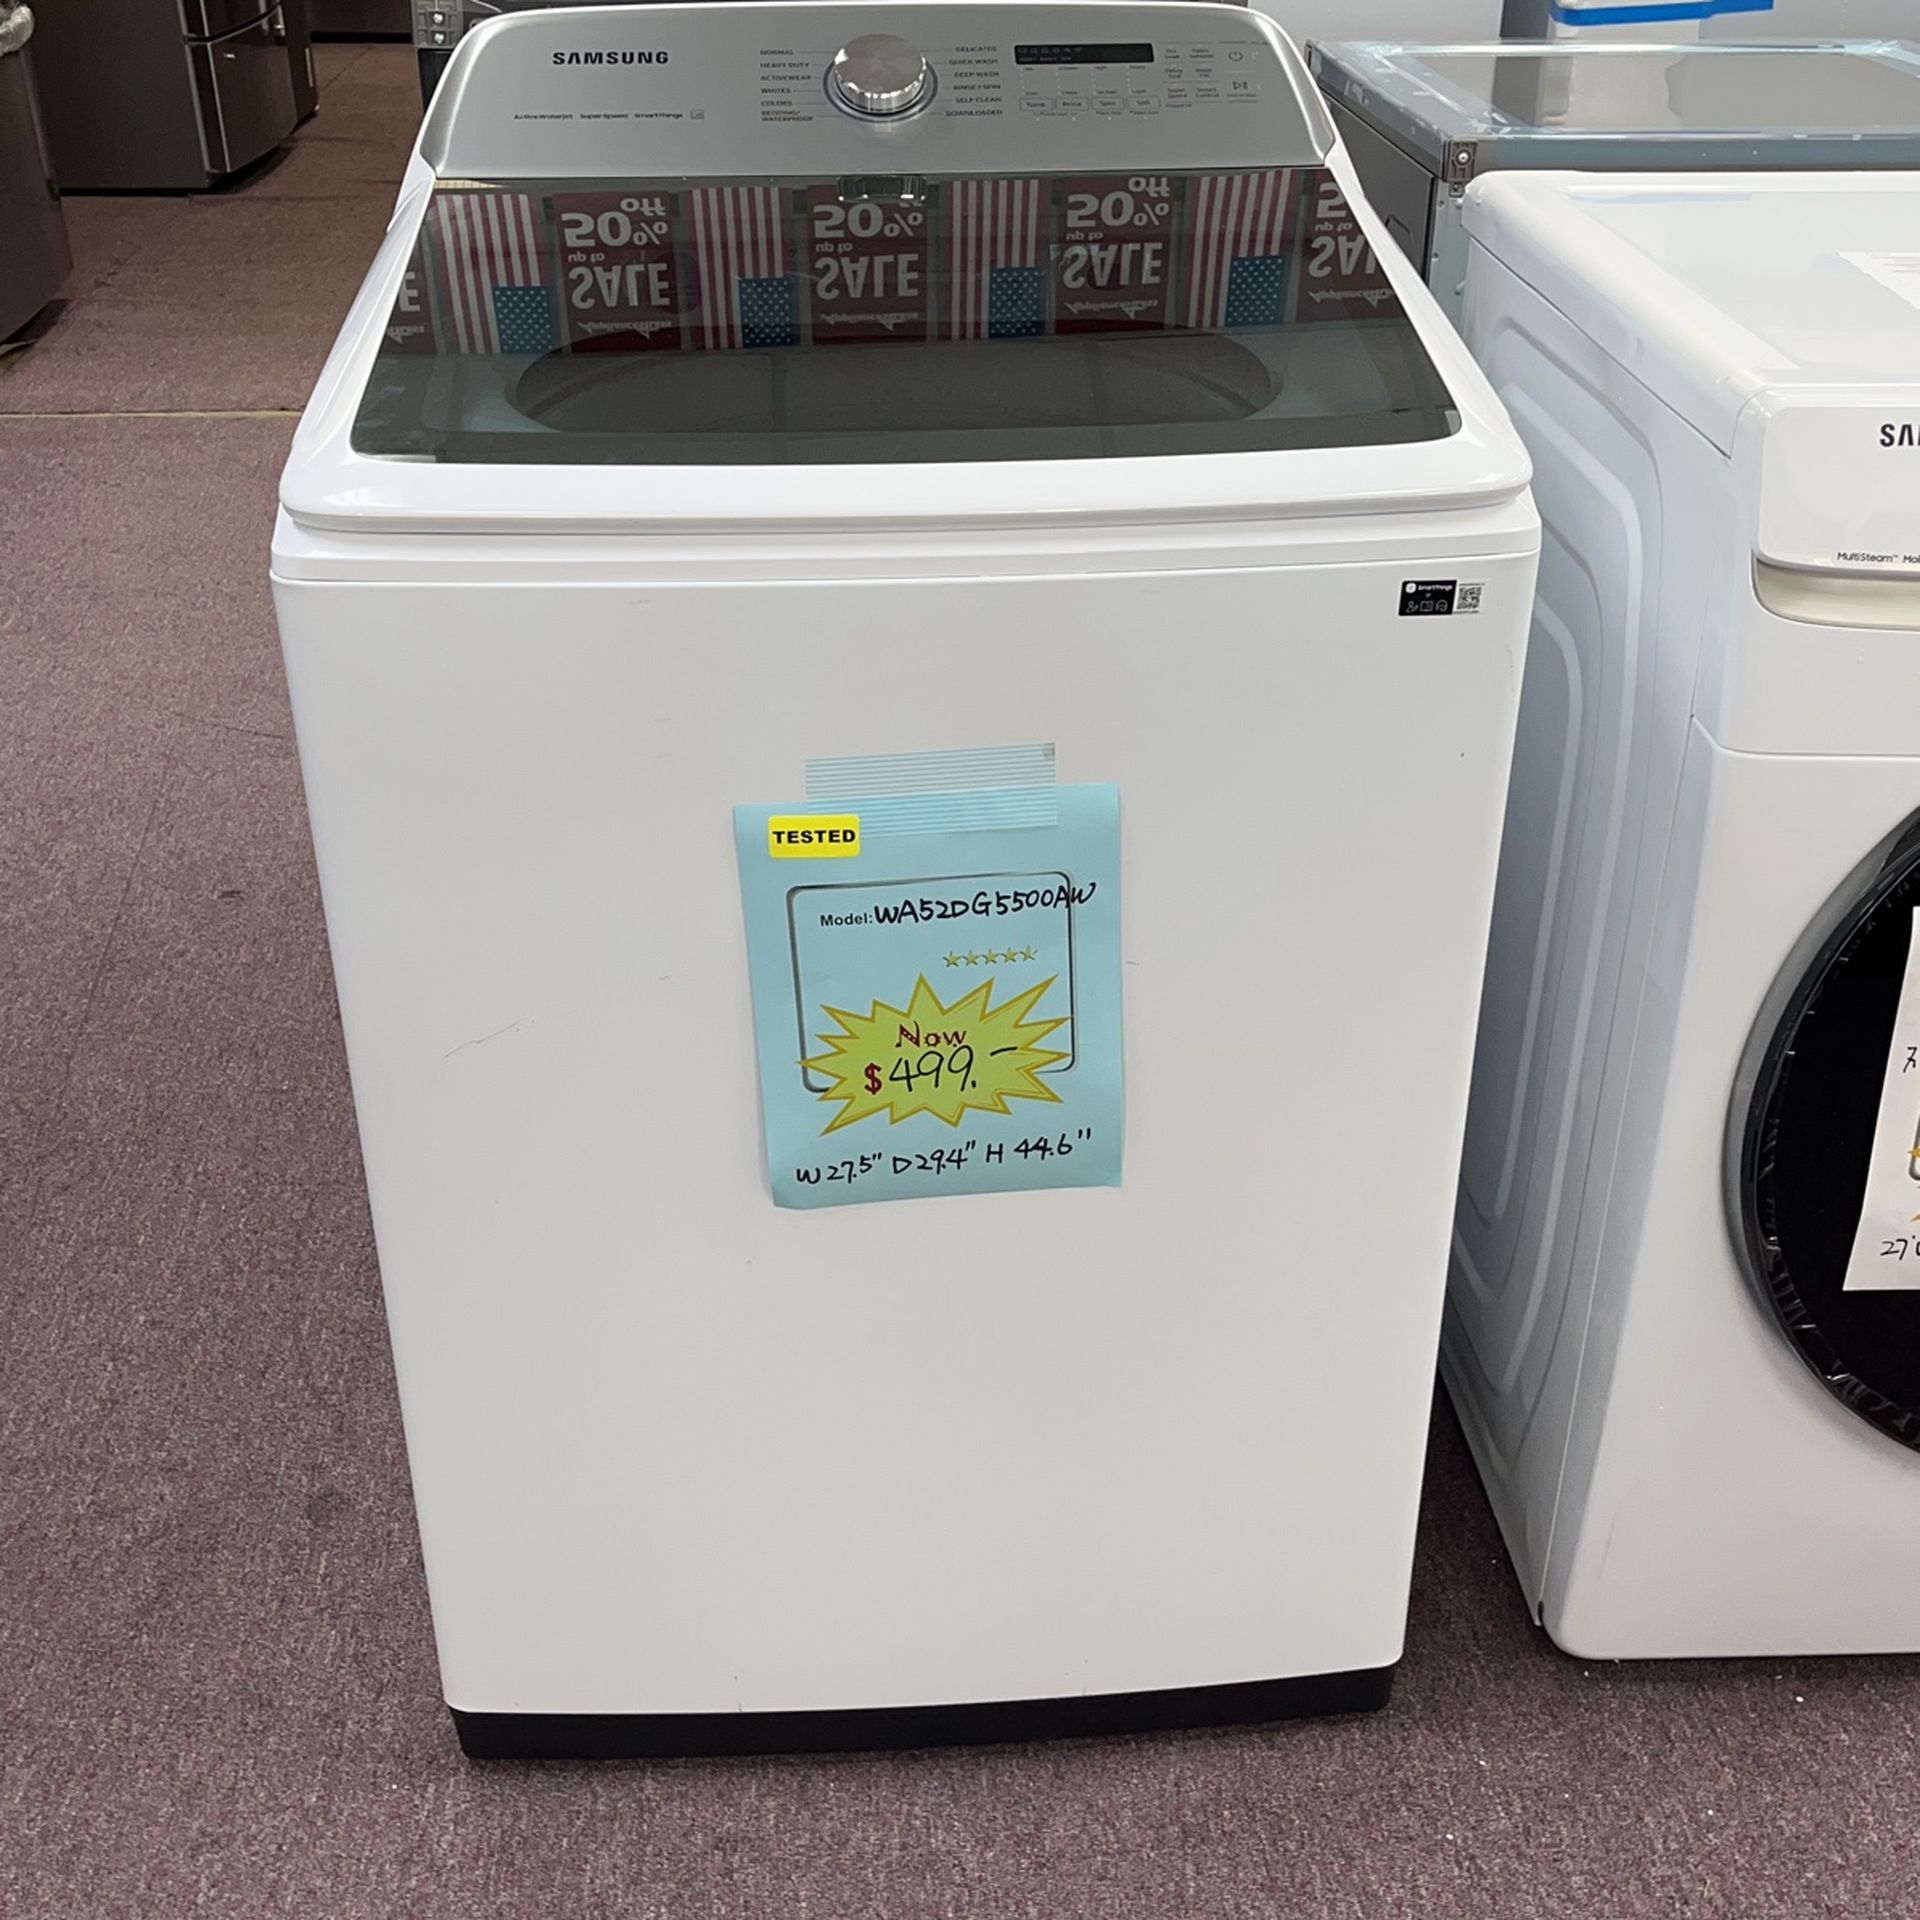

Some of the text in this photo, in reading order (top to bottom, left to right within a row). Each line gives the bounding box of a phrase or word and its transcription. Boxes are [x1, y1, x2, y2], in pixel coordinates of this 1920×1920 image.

[552, 51, 669, 65] SAMSUNG
[1879, 423, 1920, 447] SA
[772, 829, 857, 845] TESTED
[820, 882, 1097, 927] Model: WA52DG5500AW
[895, 1020, 967, 1048] Now
